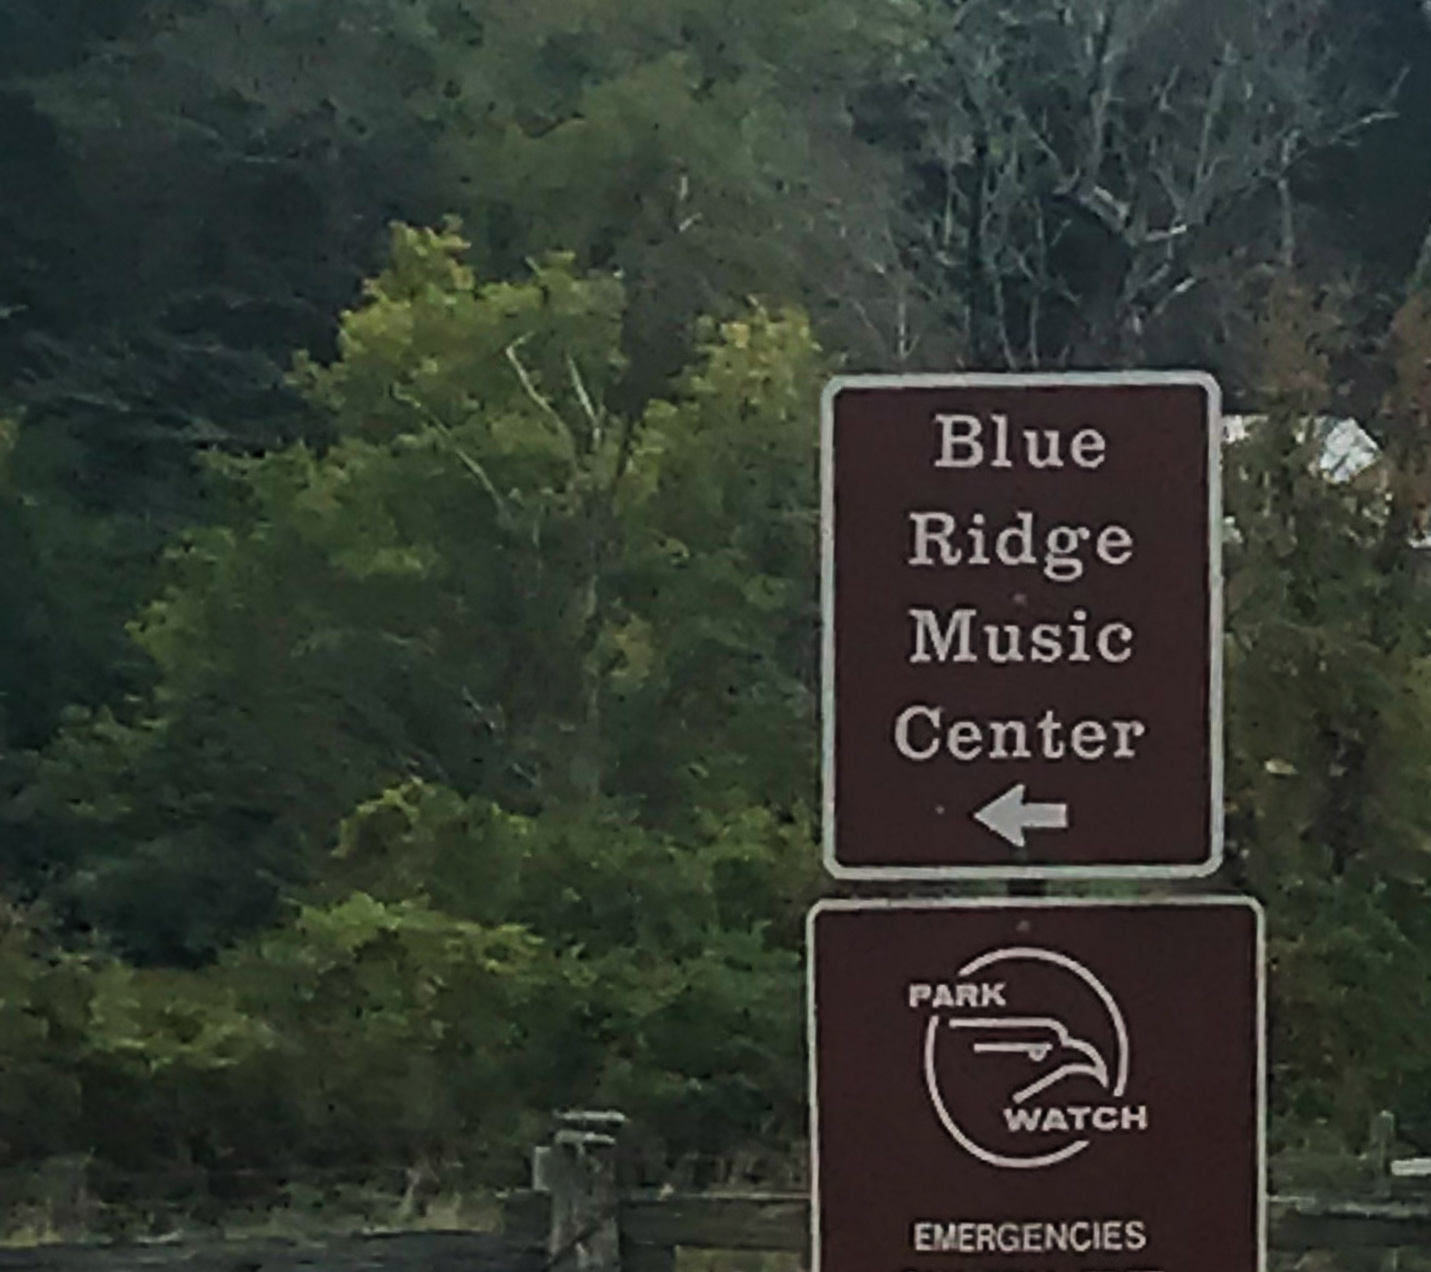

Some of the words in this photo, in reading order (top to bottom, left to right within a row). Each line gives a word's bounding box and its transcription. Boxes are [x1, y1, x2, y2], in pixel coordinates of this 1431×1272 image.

[934, 413, 1107, 469] Blue
[908, 511, 1134, 582] Ridge
[908, 608, 1134, 663] Music
[894, 704, 1146, 761] Center
[908, 982, 1006, 1008] PARK
[1003, 1105, 1148, 1132] WATCH
[913, 1220, 1147, 1252] EMERGENCIES
